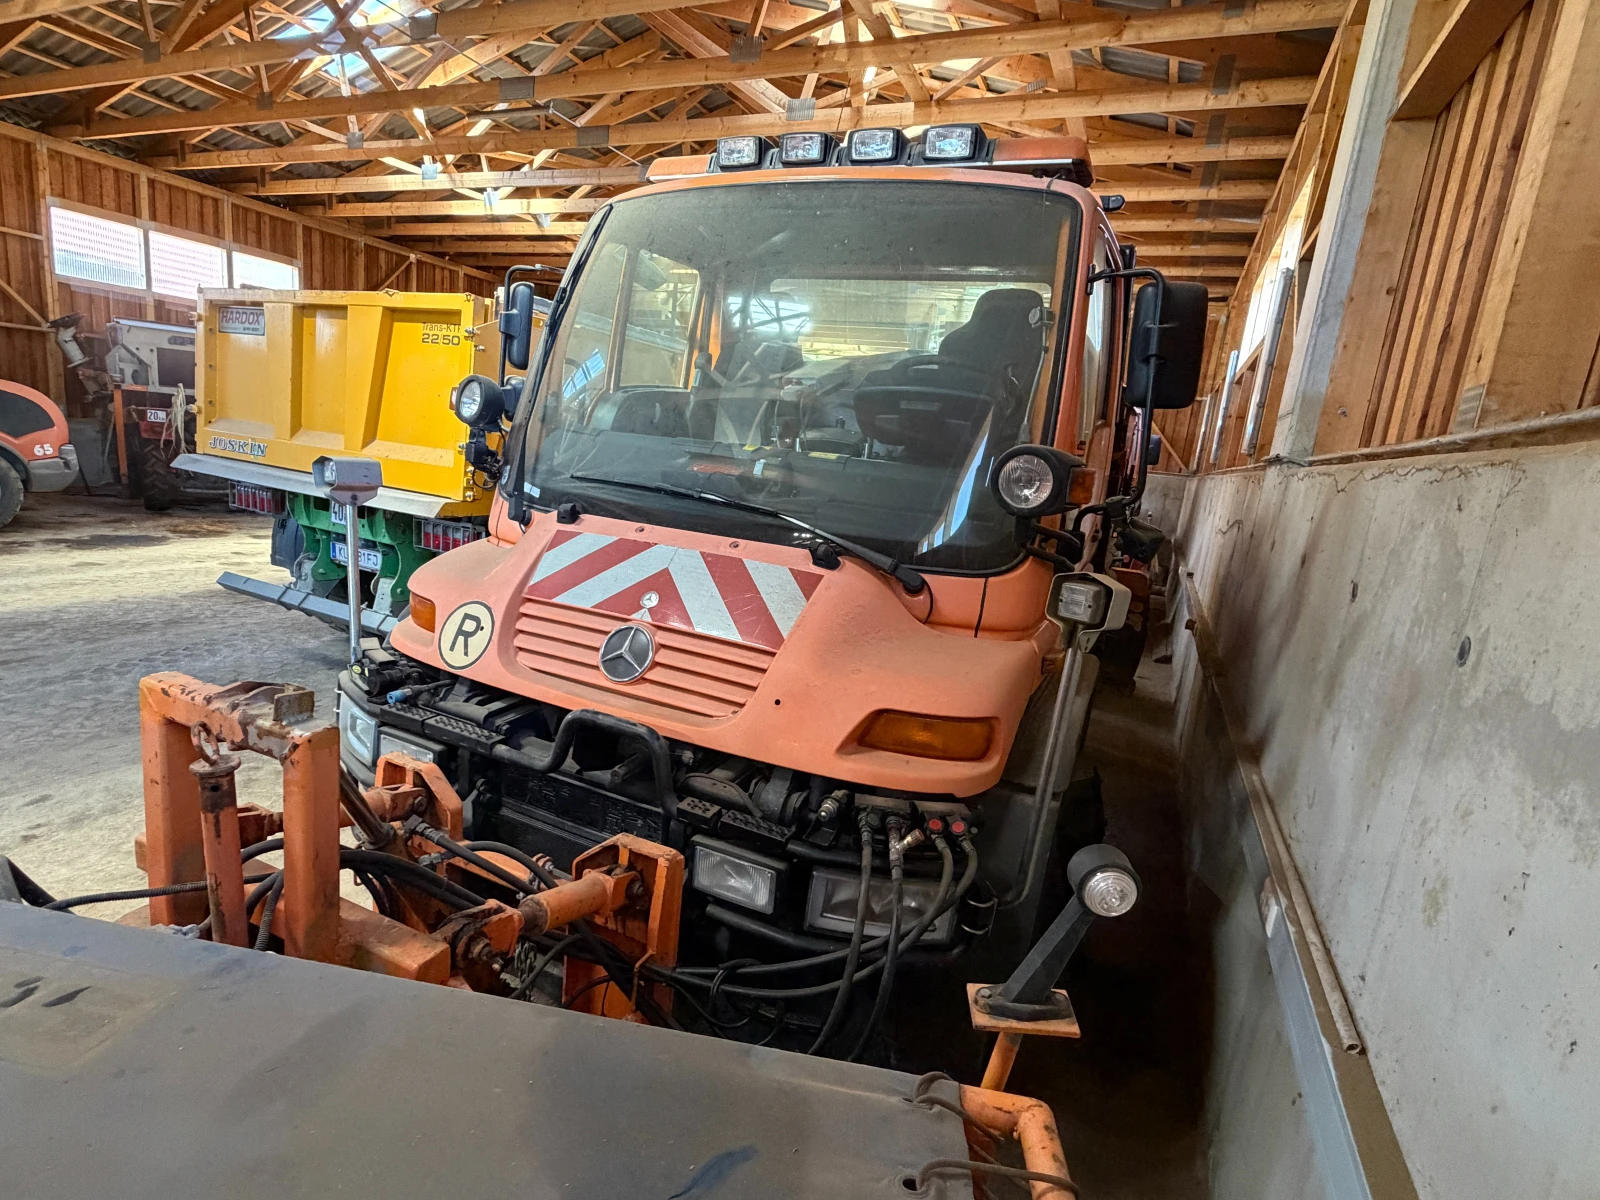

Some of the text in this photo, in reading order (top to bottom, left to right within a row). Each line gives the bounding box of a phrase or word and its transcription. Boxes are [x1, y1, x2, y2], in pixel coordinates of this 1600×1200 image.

[221, 310, 261, 326] HARDOX
[148, 411, 159, 421] 20
[33, 443, 54, 456] 65
[208, 436, 268, 457] JOSKIN
[332, 502, 344, 521] 40
[449, 612, 482, 658] R
